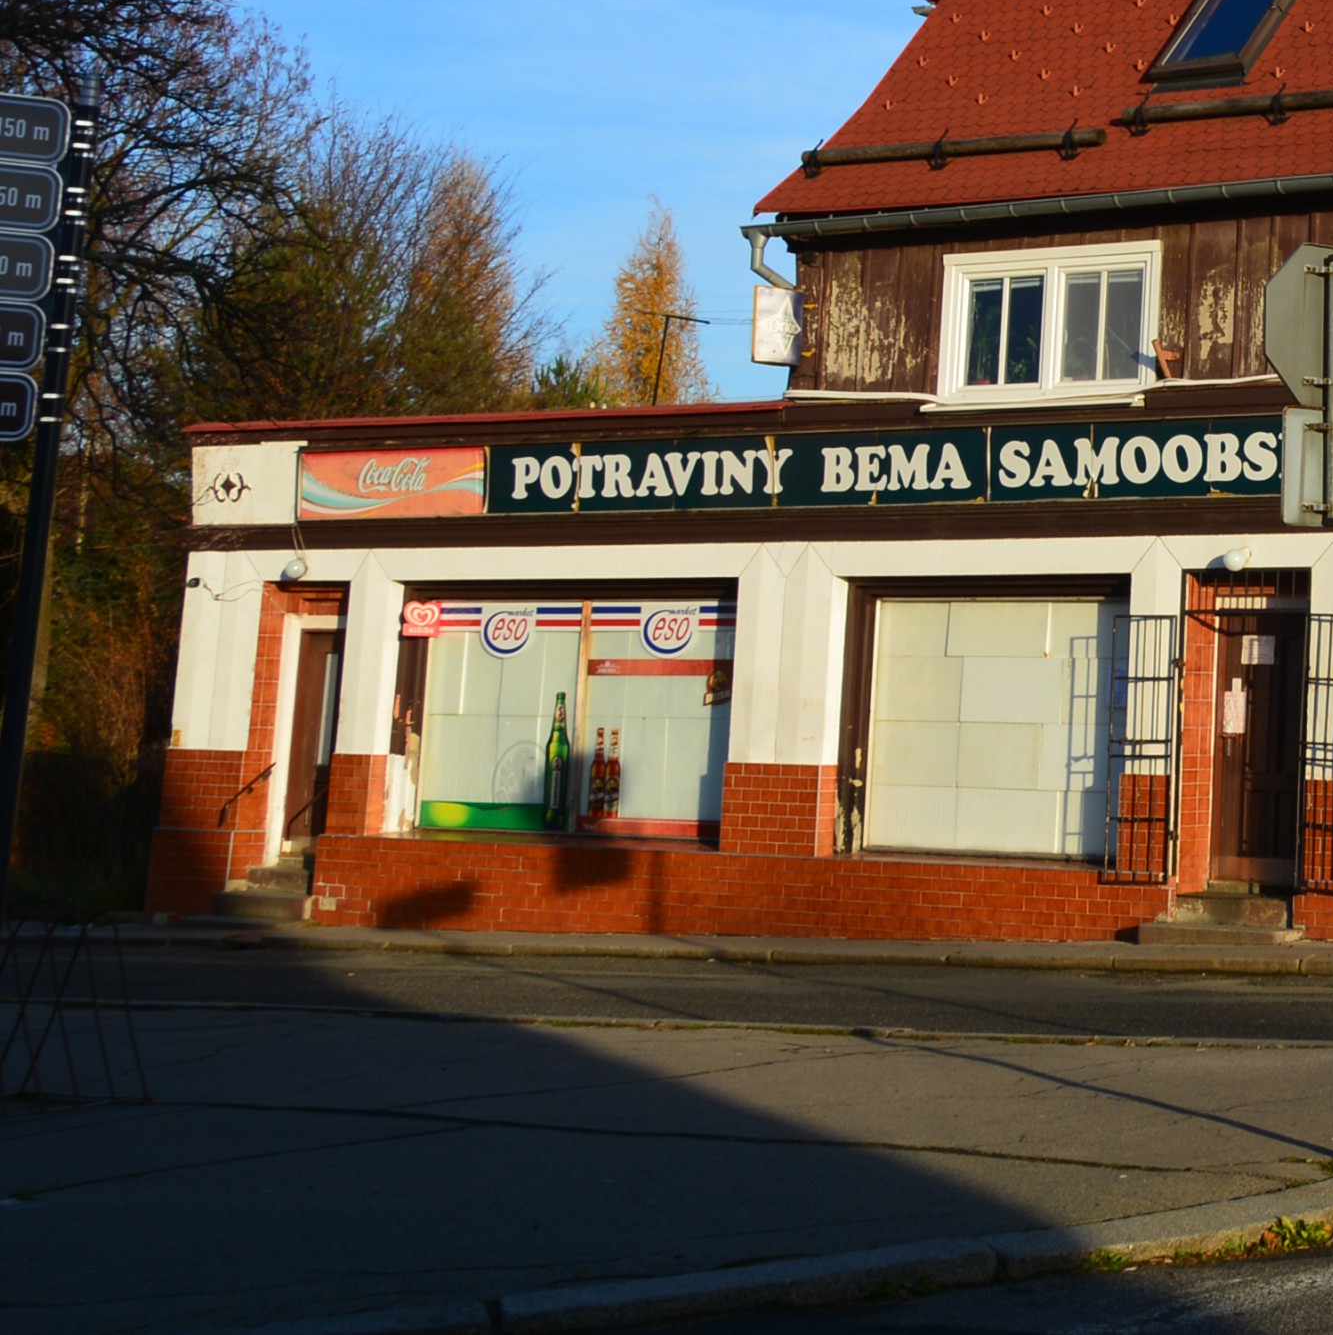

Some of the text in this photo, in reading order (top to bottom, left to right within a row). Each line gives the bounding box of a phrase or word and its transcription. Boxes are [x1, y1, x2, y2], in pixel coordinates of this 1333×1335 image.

[33, 126, 49, 141] m
[25, 194, 41, 209] m
[16, 262, 32, 277] m
[8, 331, 24, 346] m
[1, 402, 17, 417] m
[358, 456, 432, 493] Coca-Cola
[511, 448, 793, 500] POTRAVINY
[820, 442, 971, 493] BEMA
[492, 618, 528, 641] eso
[652, 617, 690, 641] eso
